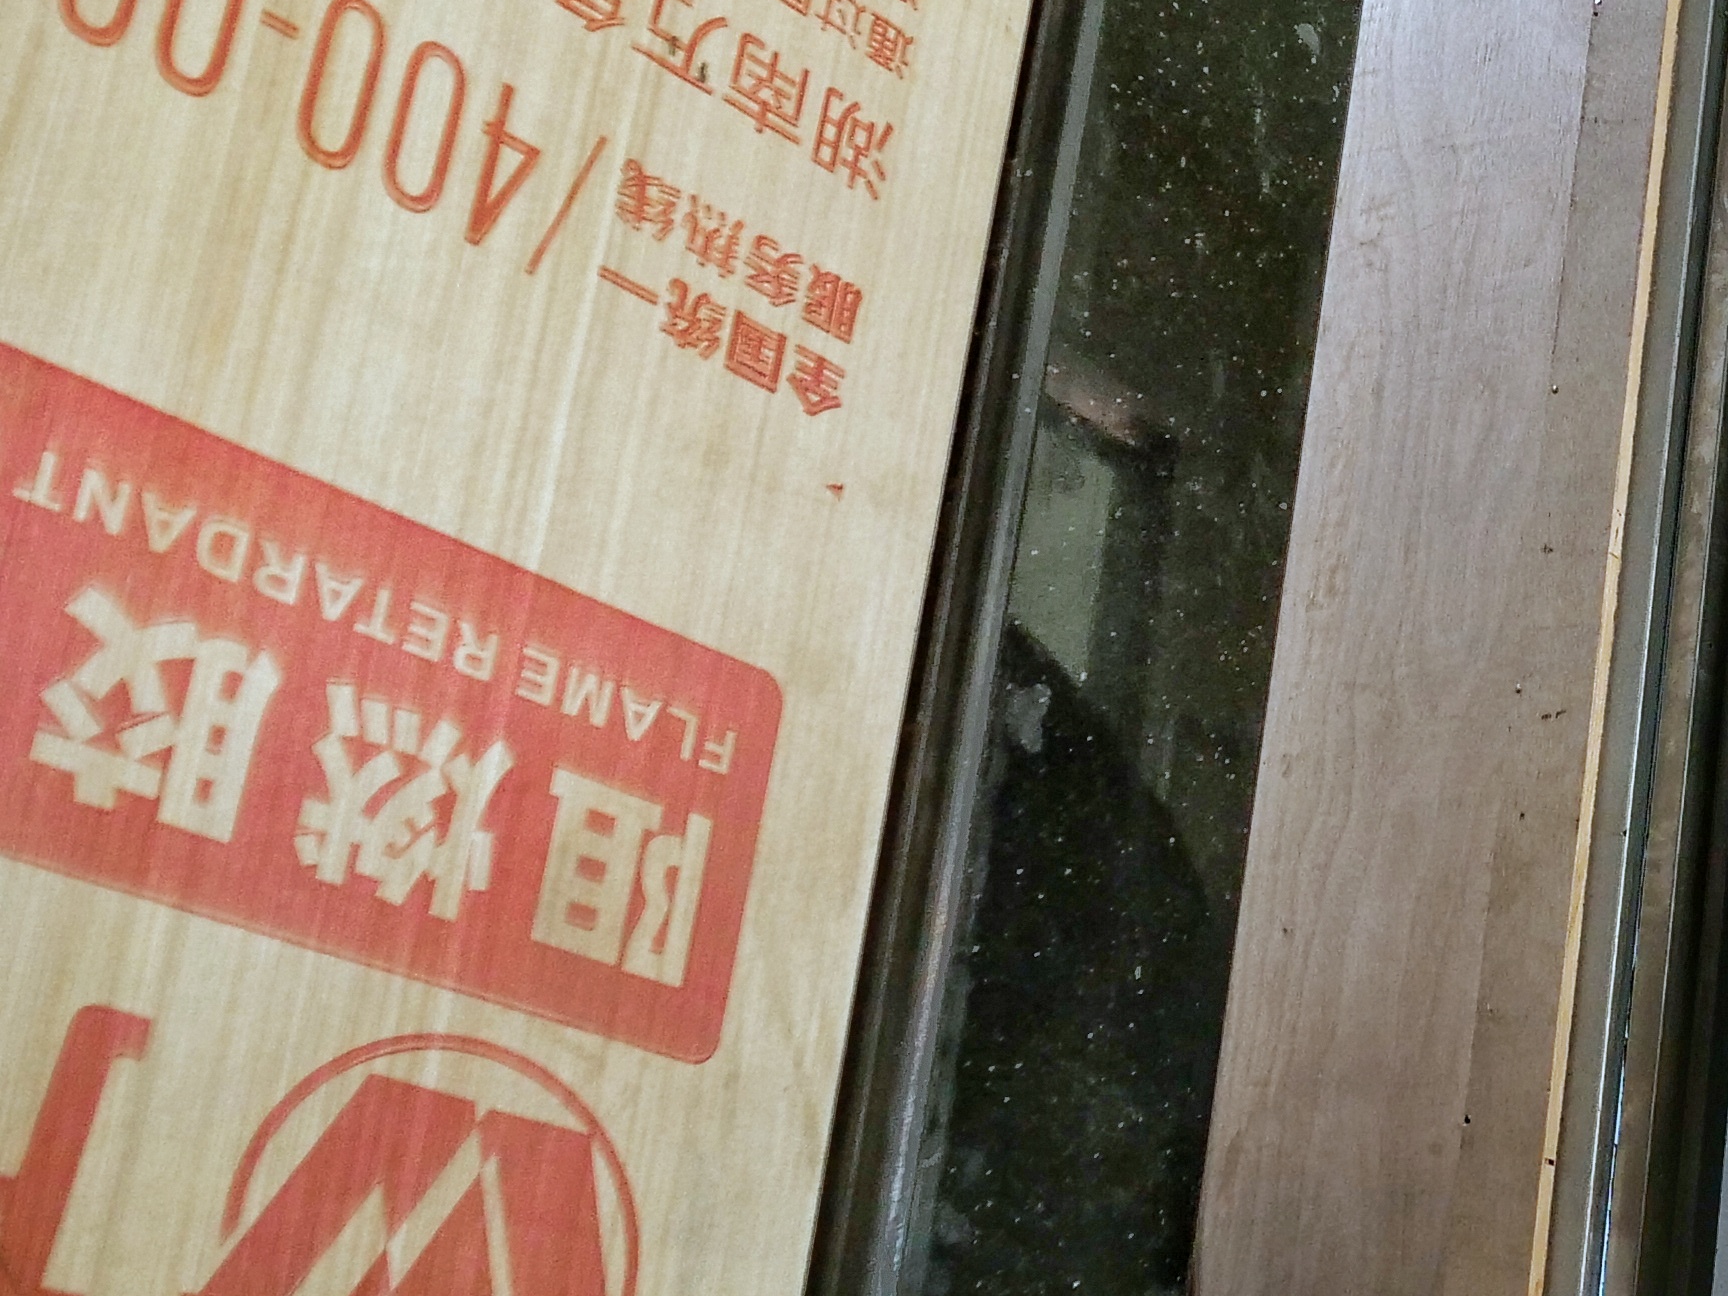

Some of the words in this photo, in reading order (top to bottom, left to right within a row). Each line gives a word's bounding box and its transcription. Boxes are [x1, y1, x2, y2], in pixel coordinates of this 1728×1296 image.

[597, 264, 847, 418] 全国统一
[614, 157, 864, 345] 服务热线
[12, 450, 500, 682] RETARDANT
[29, 585, 714, 989] 阻燃胶
[516, 642, 738, 775] FLAME
